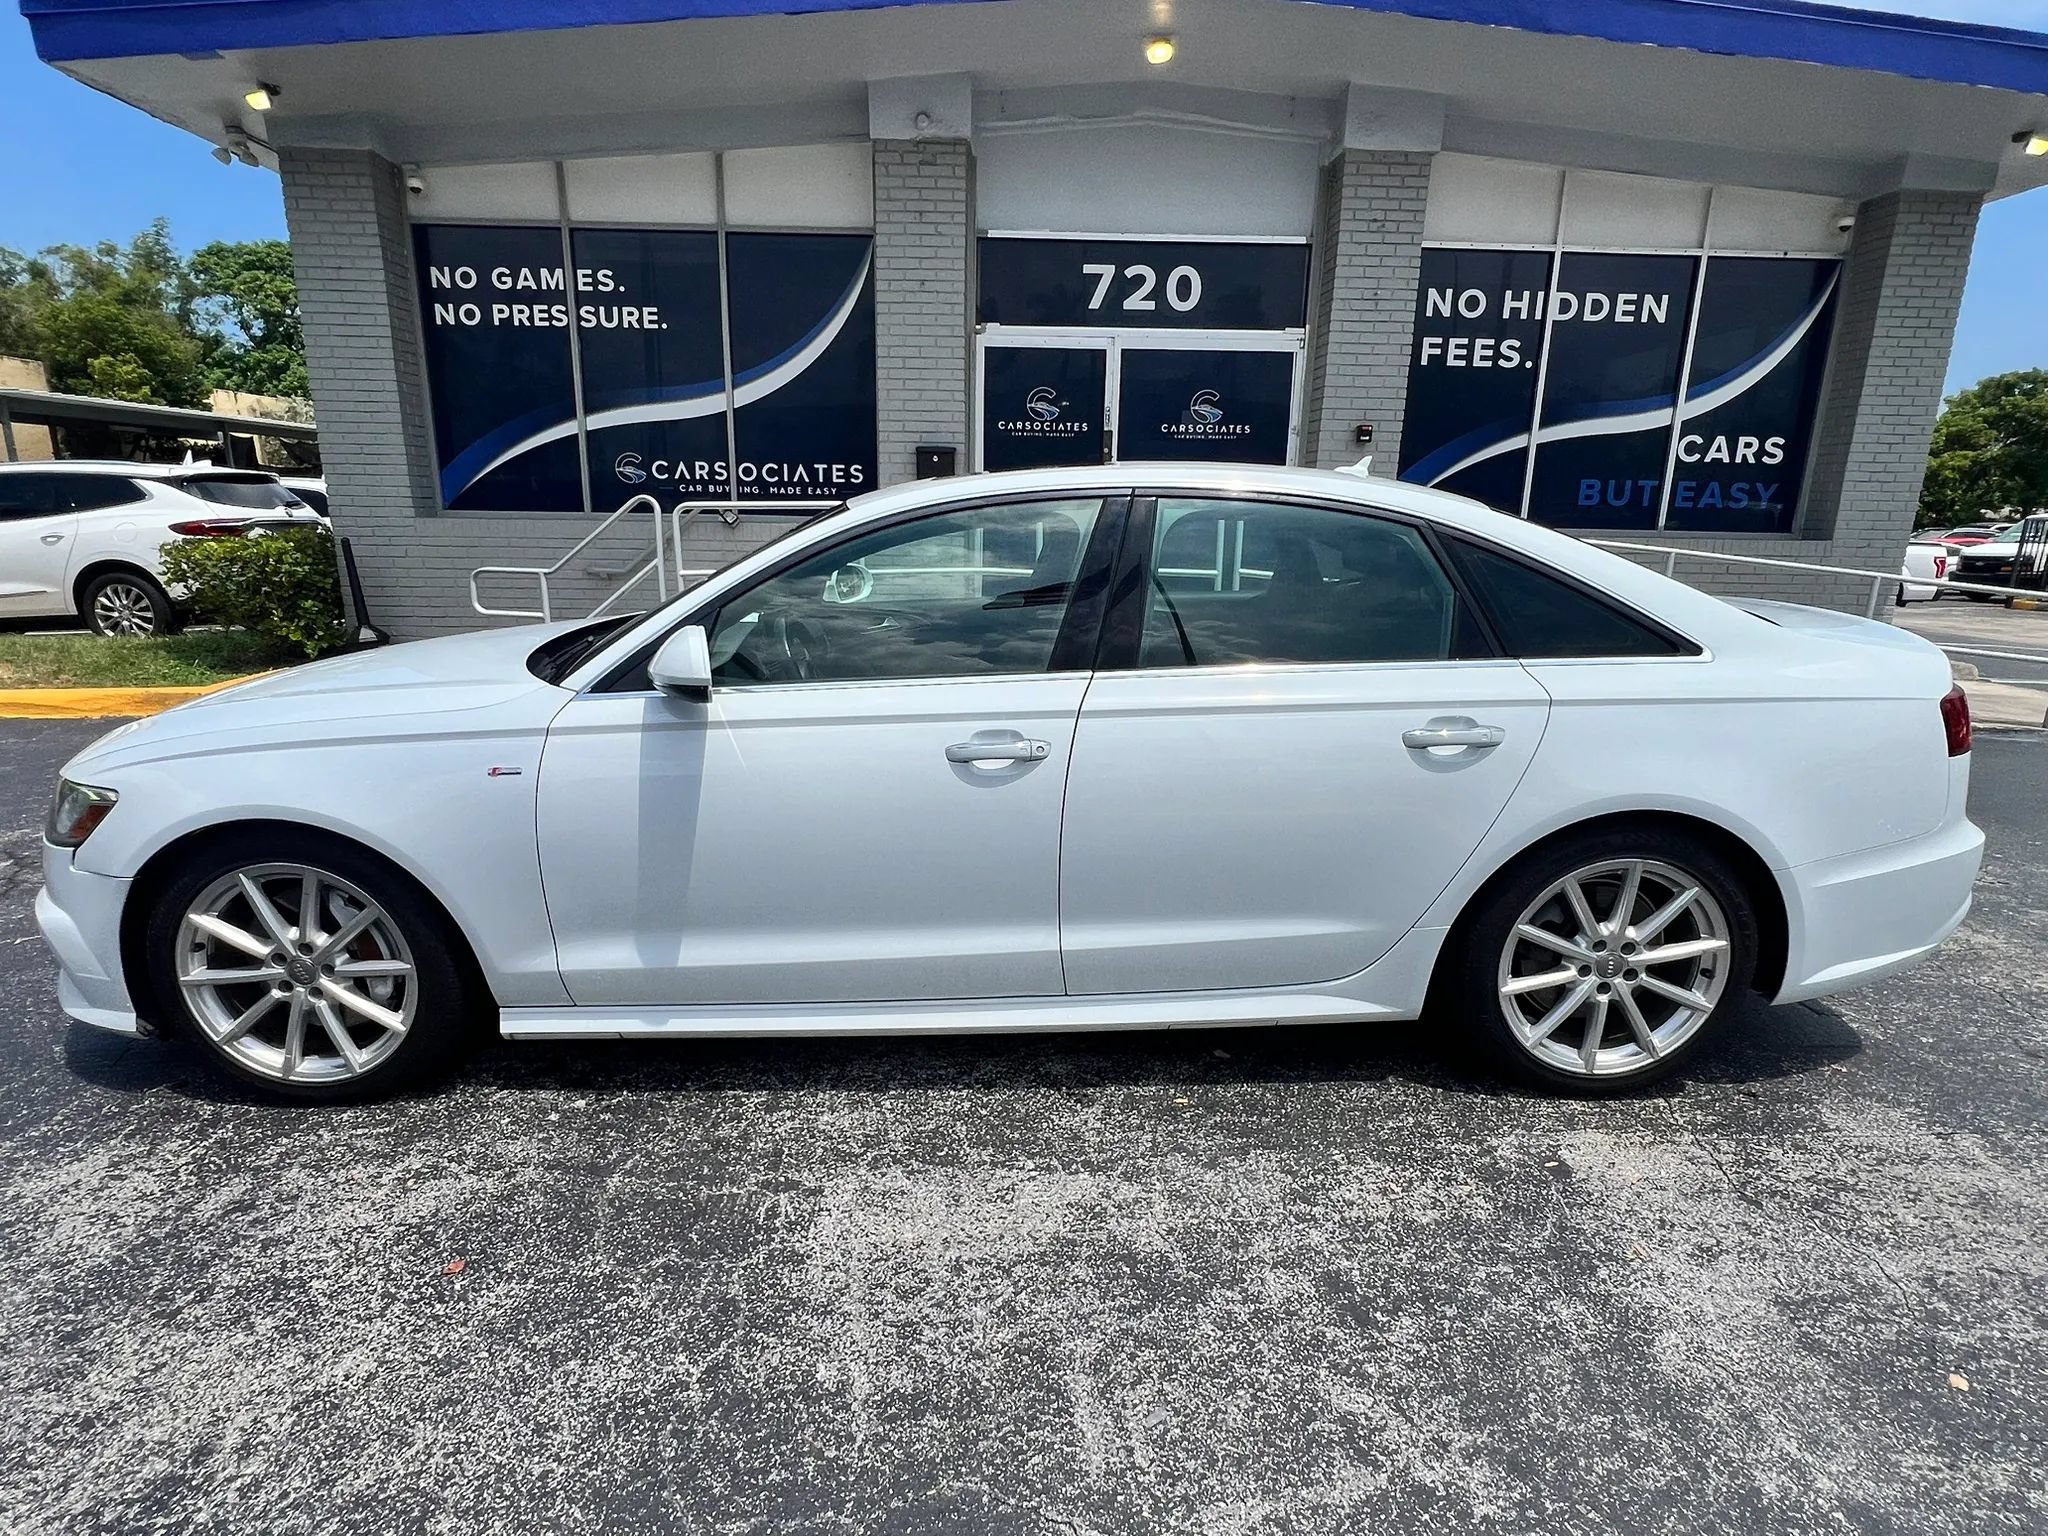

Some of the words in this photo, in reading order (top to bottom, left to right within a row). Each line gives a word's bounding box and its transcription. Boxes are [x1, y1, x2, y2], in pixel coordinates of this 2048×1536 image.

[430, 265, 478, 290] NO
[490, 266, 626, 293] GAMES.
[1082, 263, 1203, 313] 720
[434, 303, 482, 326] NO
[492, 303, 669, 330] PRESSURE.
[1424, 287, 1487, 320] NO
[1502, 289, 1670, 324] HIDDEN
[1420, 336, 1534, 370] FEES.
[998, 421, 1089, 432] CARSOCIATES
[1161, 424, 1251, 434] CARSOCIATES
[1677, 434, 1786, 465] CARS
[651, 460, 864, 483] CARSOCIATES
[679, 484, 703, 493] CAR
[769, 486, 802, 495] MADE
[807, 487, 838, 496] EASY
[1577, 479, 1660, 507] BUT
